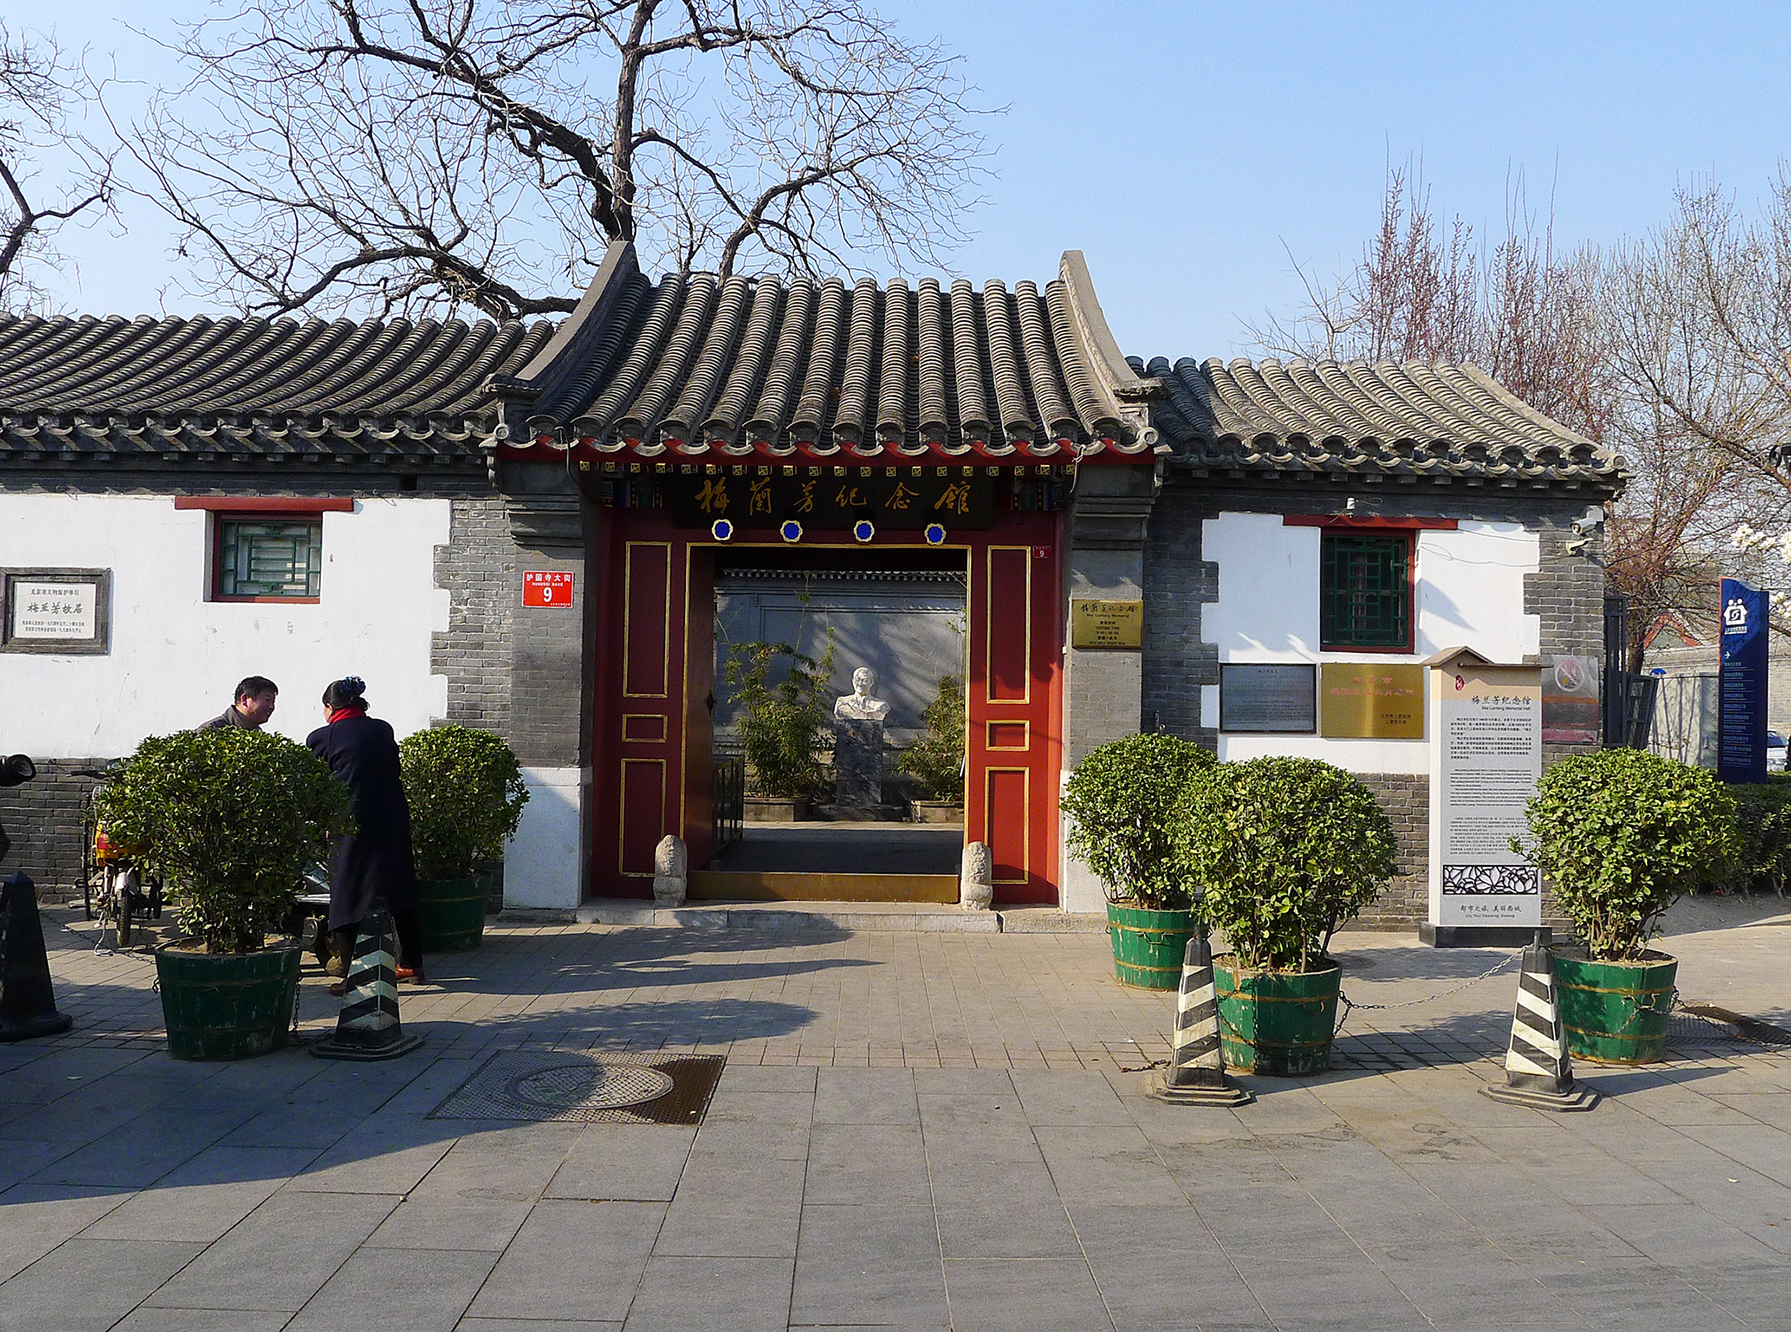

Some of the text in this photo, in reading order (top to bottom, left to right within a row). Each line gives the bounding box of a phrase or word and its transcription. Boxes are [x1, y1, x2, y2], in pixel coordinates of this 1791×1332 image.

[526, 573, 571, 582] 护国寺大街
[543, 586, 553, 602] 9
[27, 601, 83, 615] 梅兰芳故居
[1471, 695, 1531, 705] 梅兰芳纪念馆
